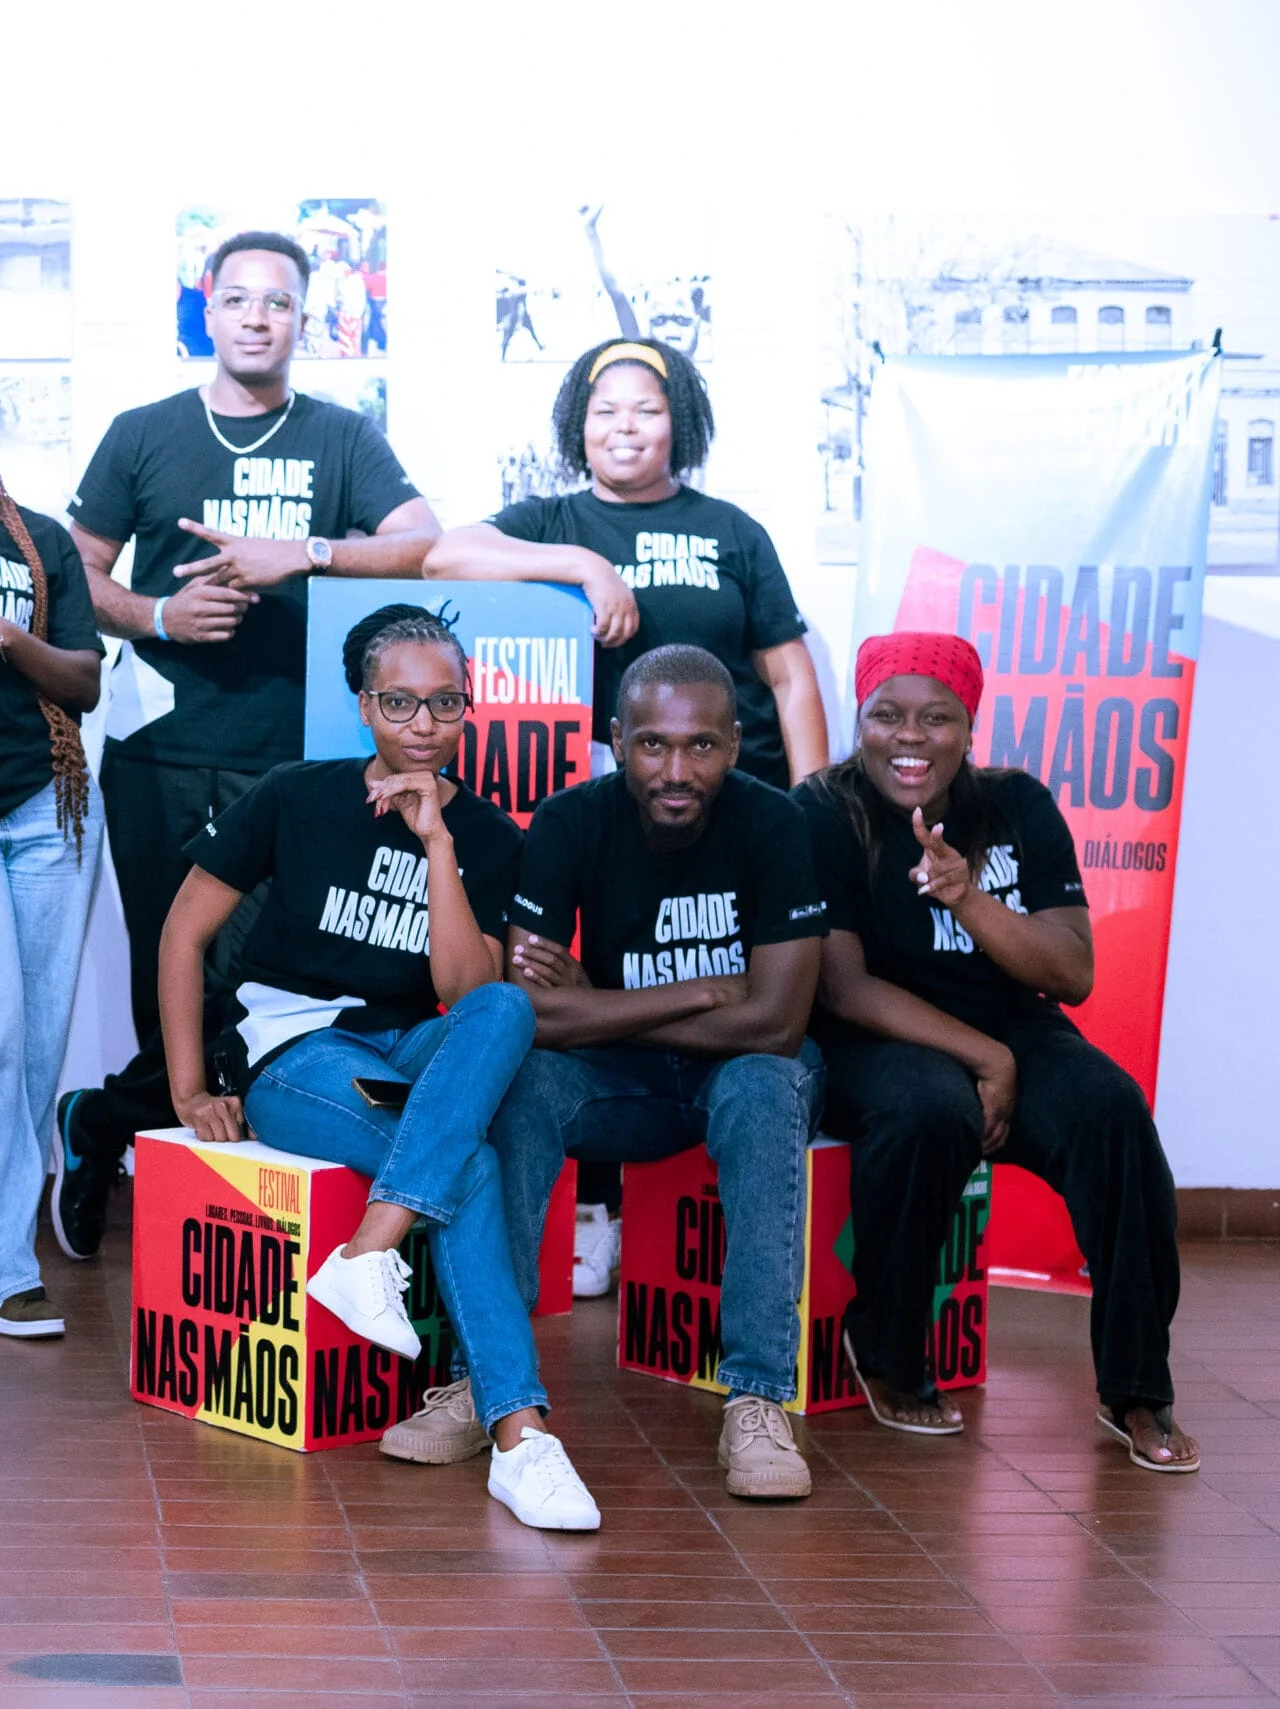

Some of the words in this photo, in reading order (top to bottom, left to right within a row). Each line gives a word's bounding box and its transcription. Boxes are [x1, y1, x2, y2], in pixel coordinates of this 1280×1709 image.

[233, 457, 315, 499] CIDADE
[635, 531, 720, 563] CIDADE
[614, 563, 652, 589] AS
[957, 563, 1192, 679] CIDADE
[474, 636, 581, 704] FESTIVAL
[447, 719, 581, 813] DADE
[368, 846, 429, 904] CIDA
[1083, 833, 1168, 872] DIÁLOGOS
[368, 900, 430, 956] MÃO
[655, 892, 741, 944] CIDADE
[258, 1167, 301, 1215] FESTIVAL
[181, 1218, 300, 1333] CIDADE
